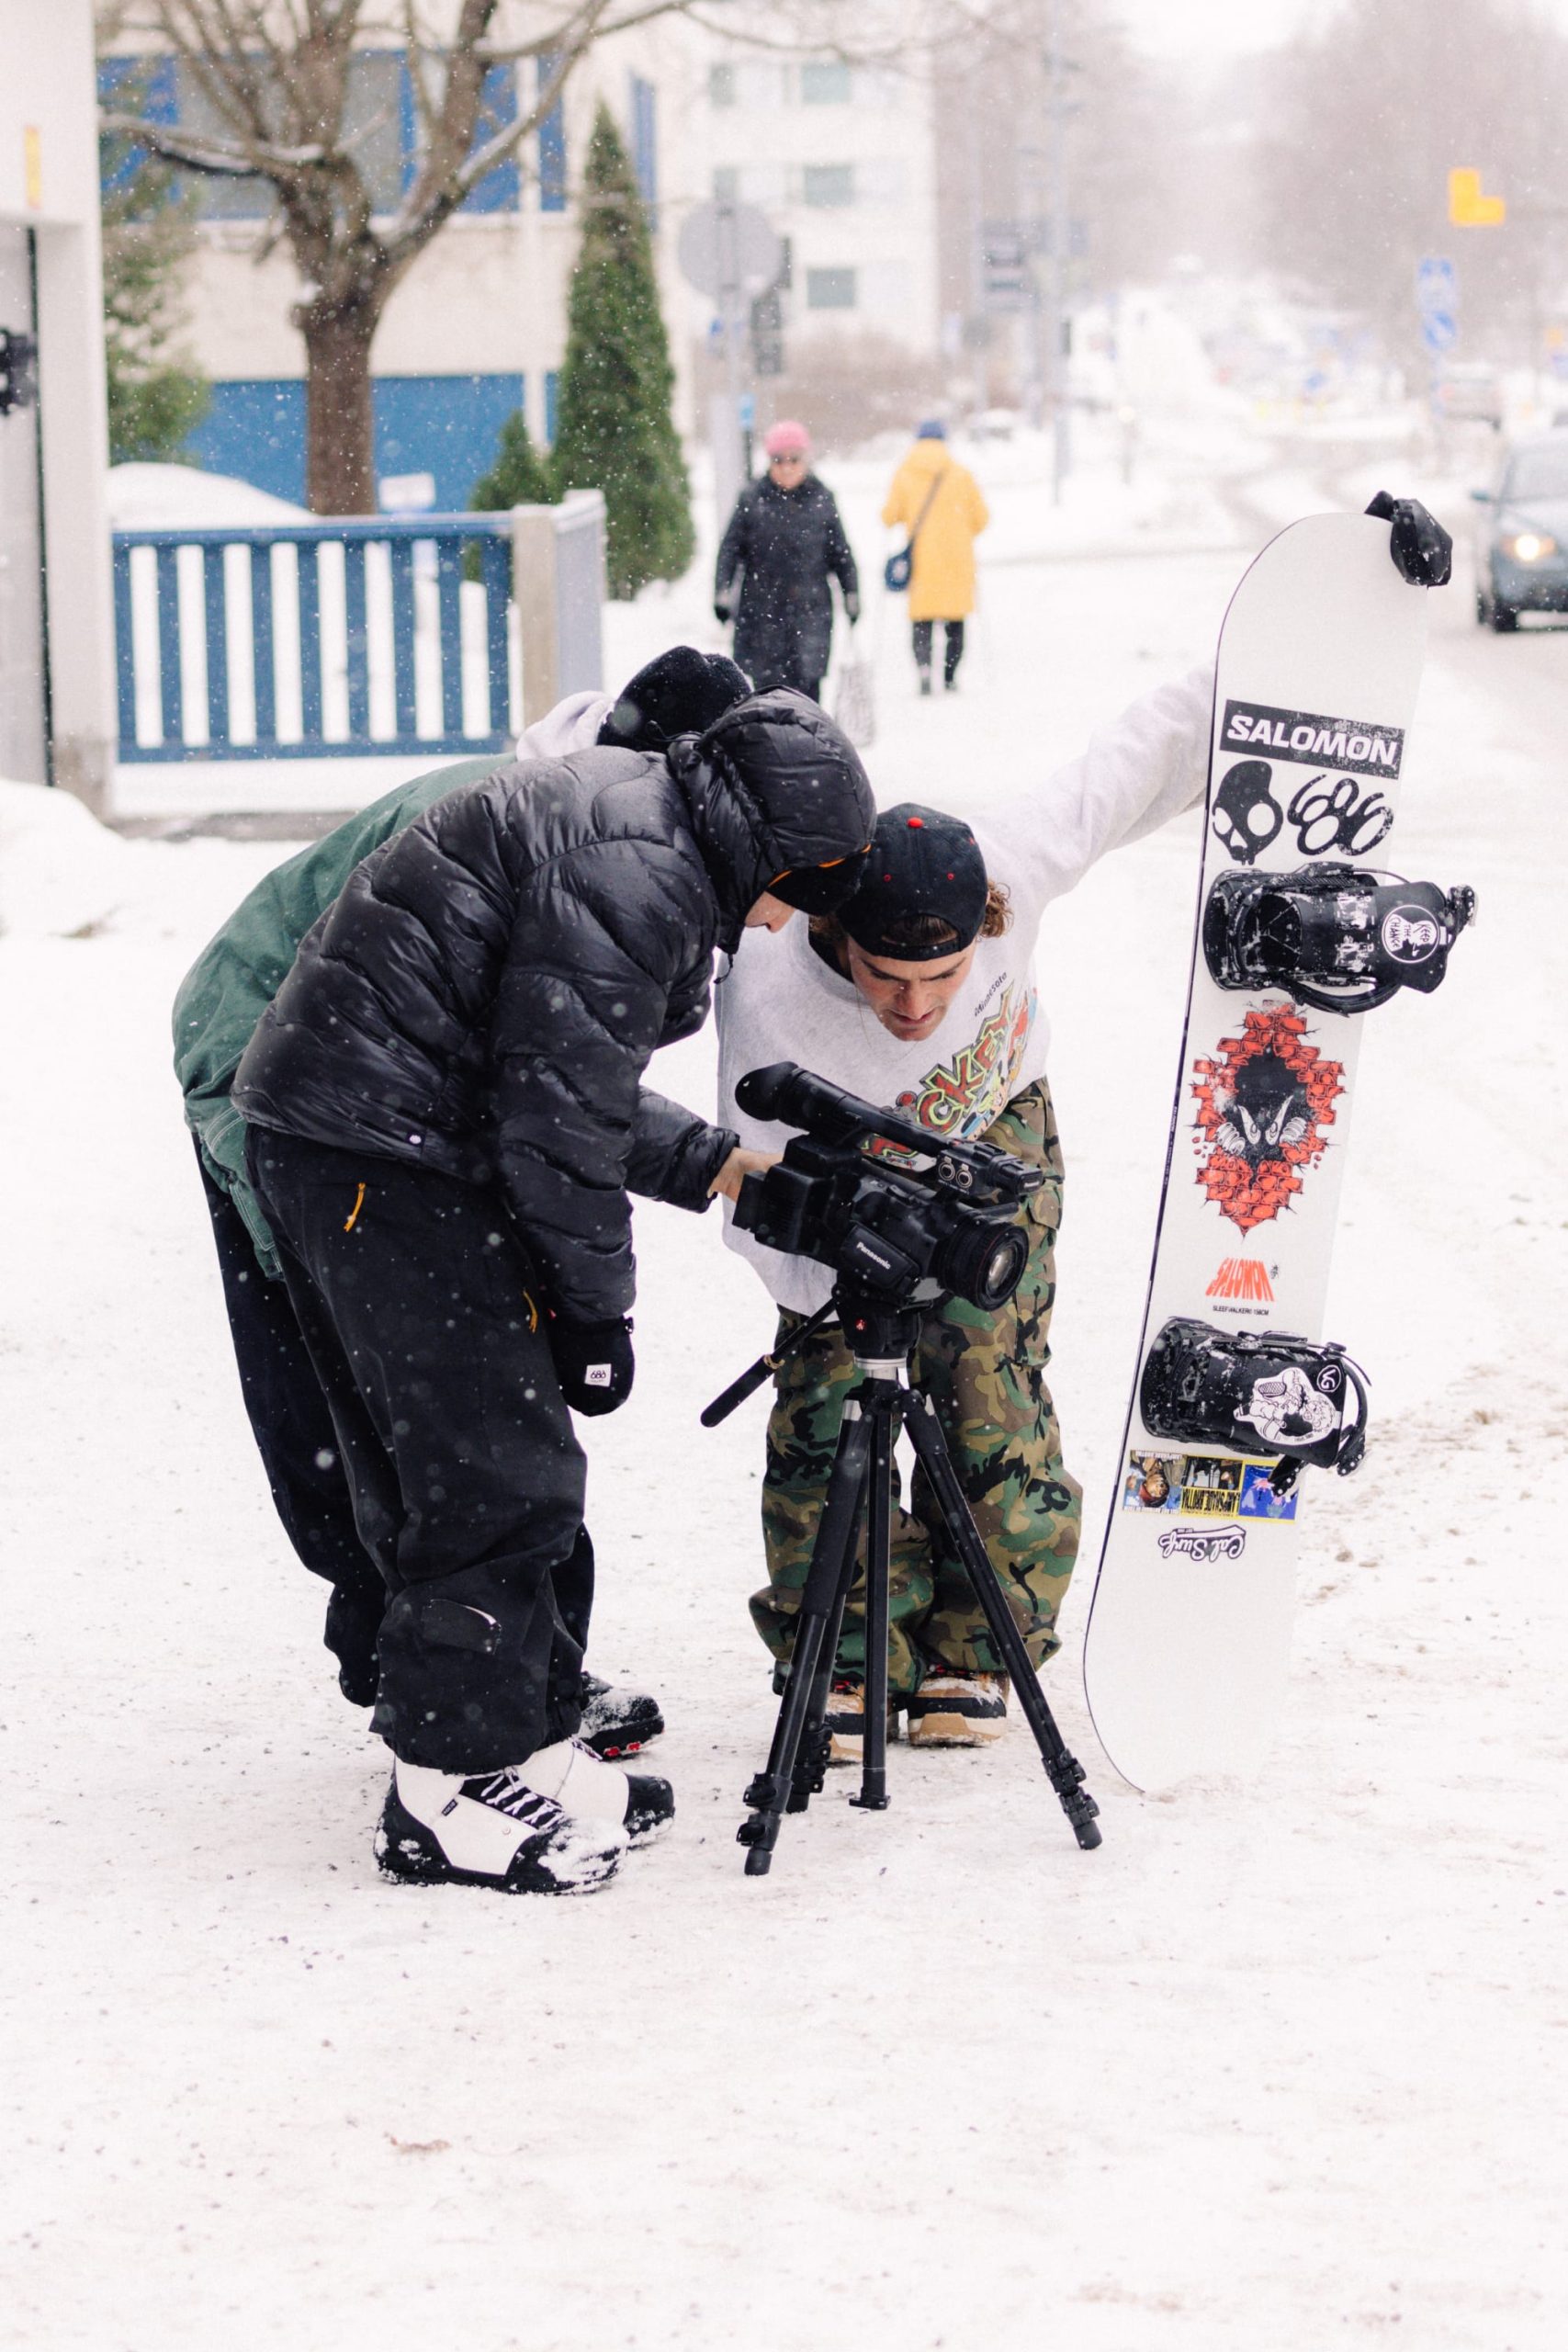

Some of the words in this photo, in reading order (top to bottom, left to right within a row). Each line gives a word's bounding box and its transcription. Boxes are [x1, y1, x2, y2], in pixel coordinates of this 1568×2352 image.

[1227, 714, 1397, 765] SALOMON
[1287, 774, 1395, 855] 686
[1388, 917, 1402, 948] CHANGE
[1413, 923, 1431, 943] KEEP
[975, 972, 1007, 1017] Minnesota
[856, 1241, 891, 1270] Panasonic
[1159, 1532, 1208, 1560] Surf
[1209, 1535, 1244, 1562] Cal
